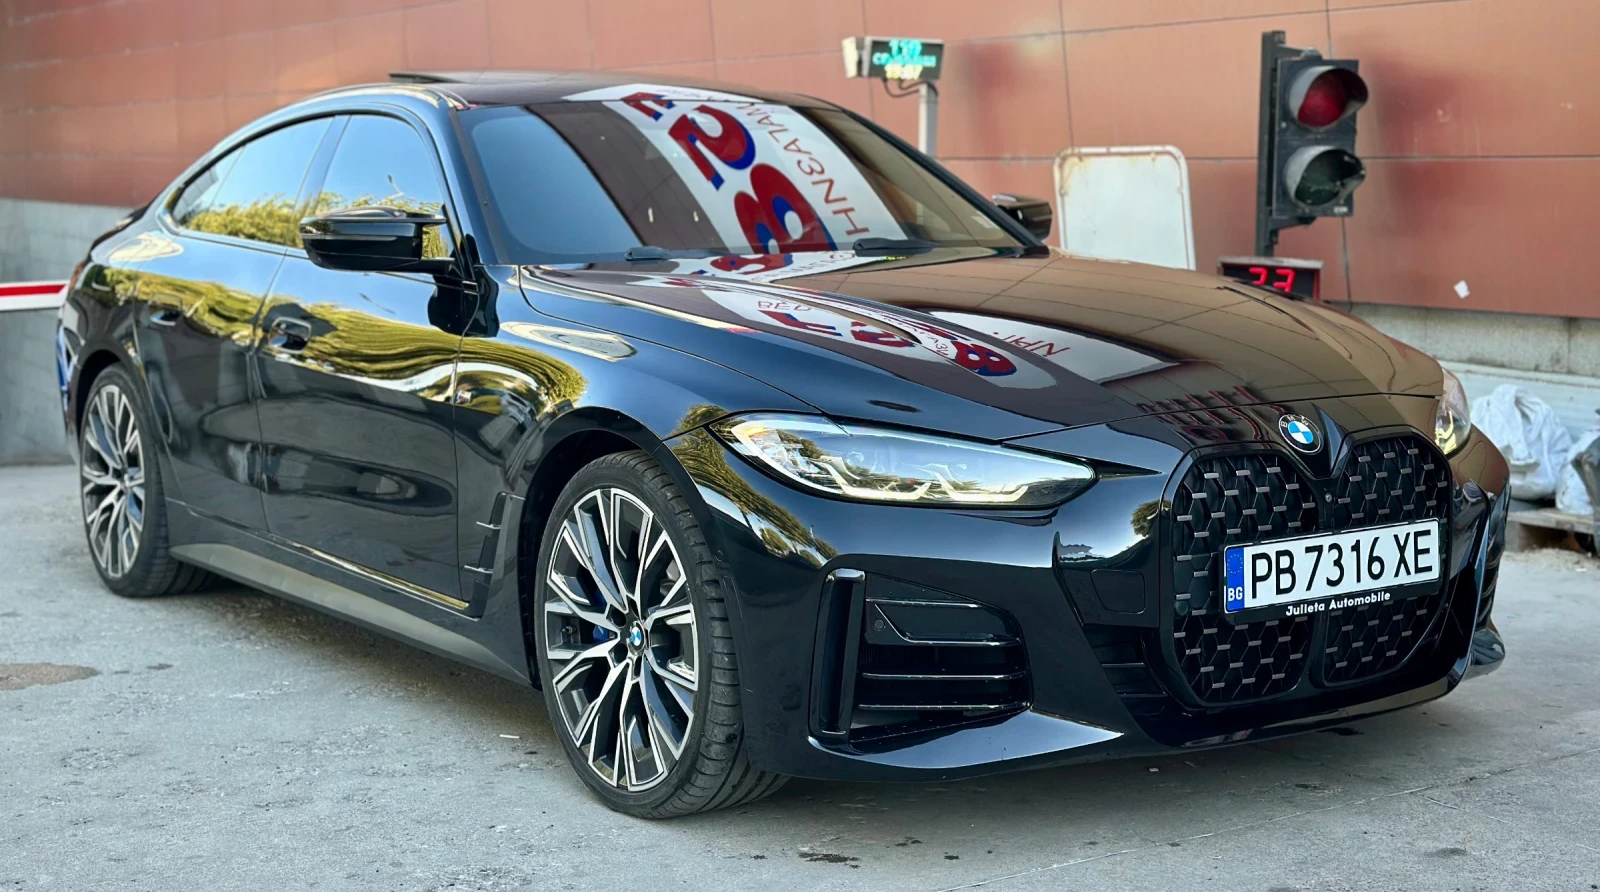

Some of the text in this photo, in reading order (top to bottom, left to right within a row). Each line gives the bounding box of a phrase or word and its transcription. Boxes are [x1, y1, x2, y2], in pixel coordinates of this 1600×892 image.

[1250, 529, 1433, 600] PB 7316 XE
[1227, 586, 1244, 602] BG
[1285, 591, 1391, 617] Julieta Automobile
